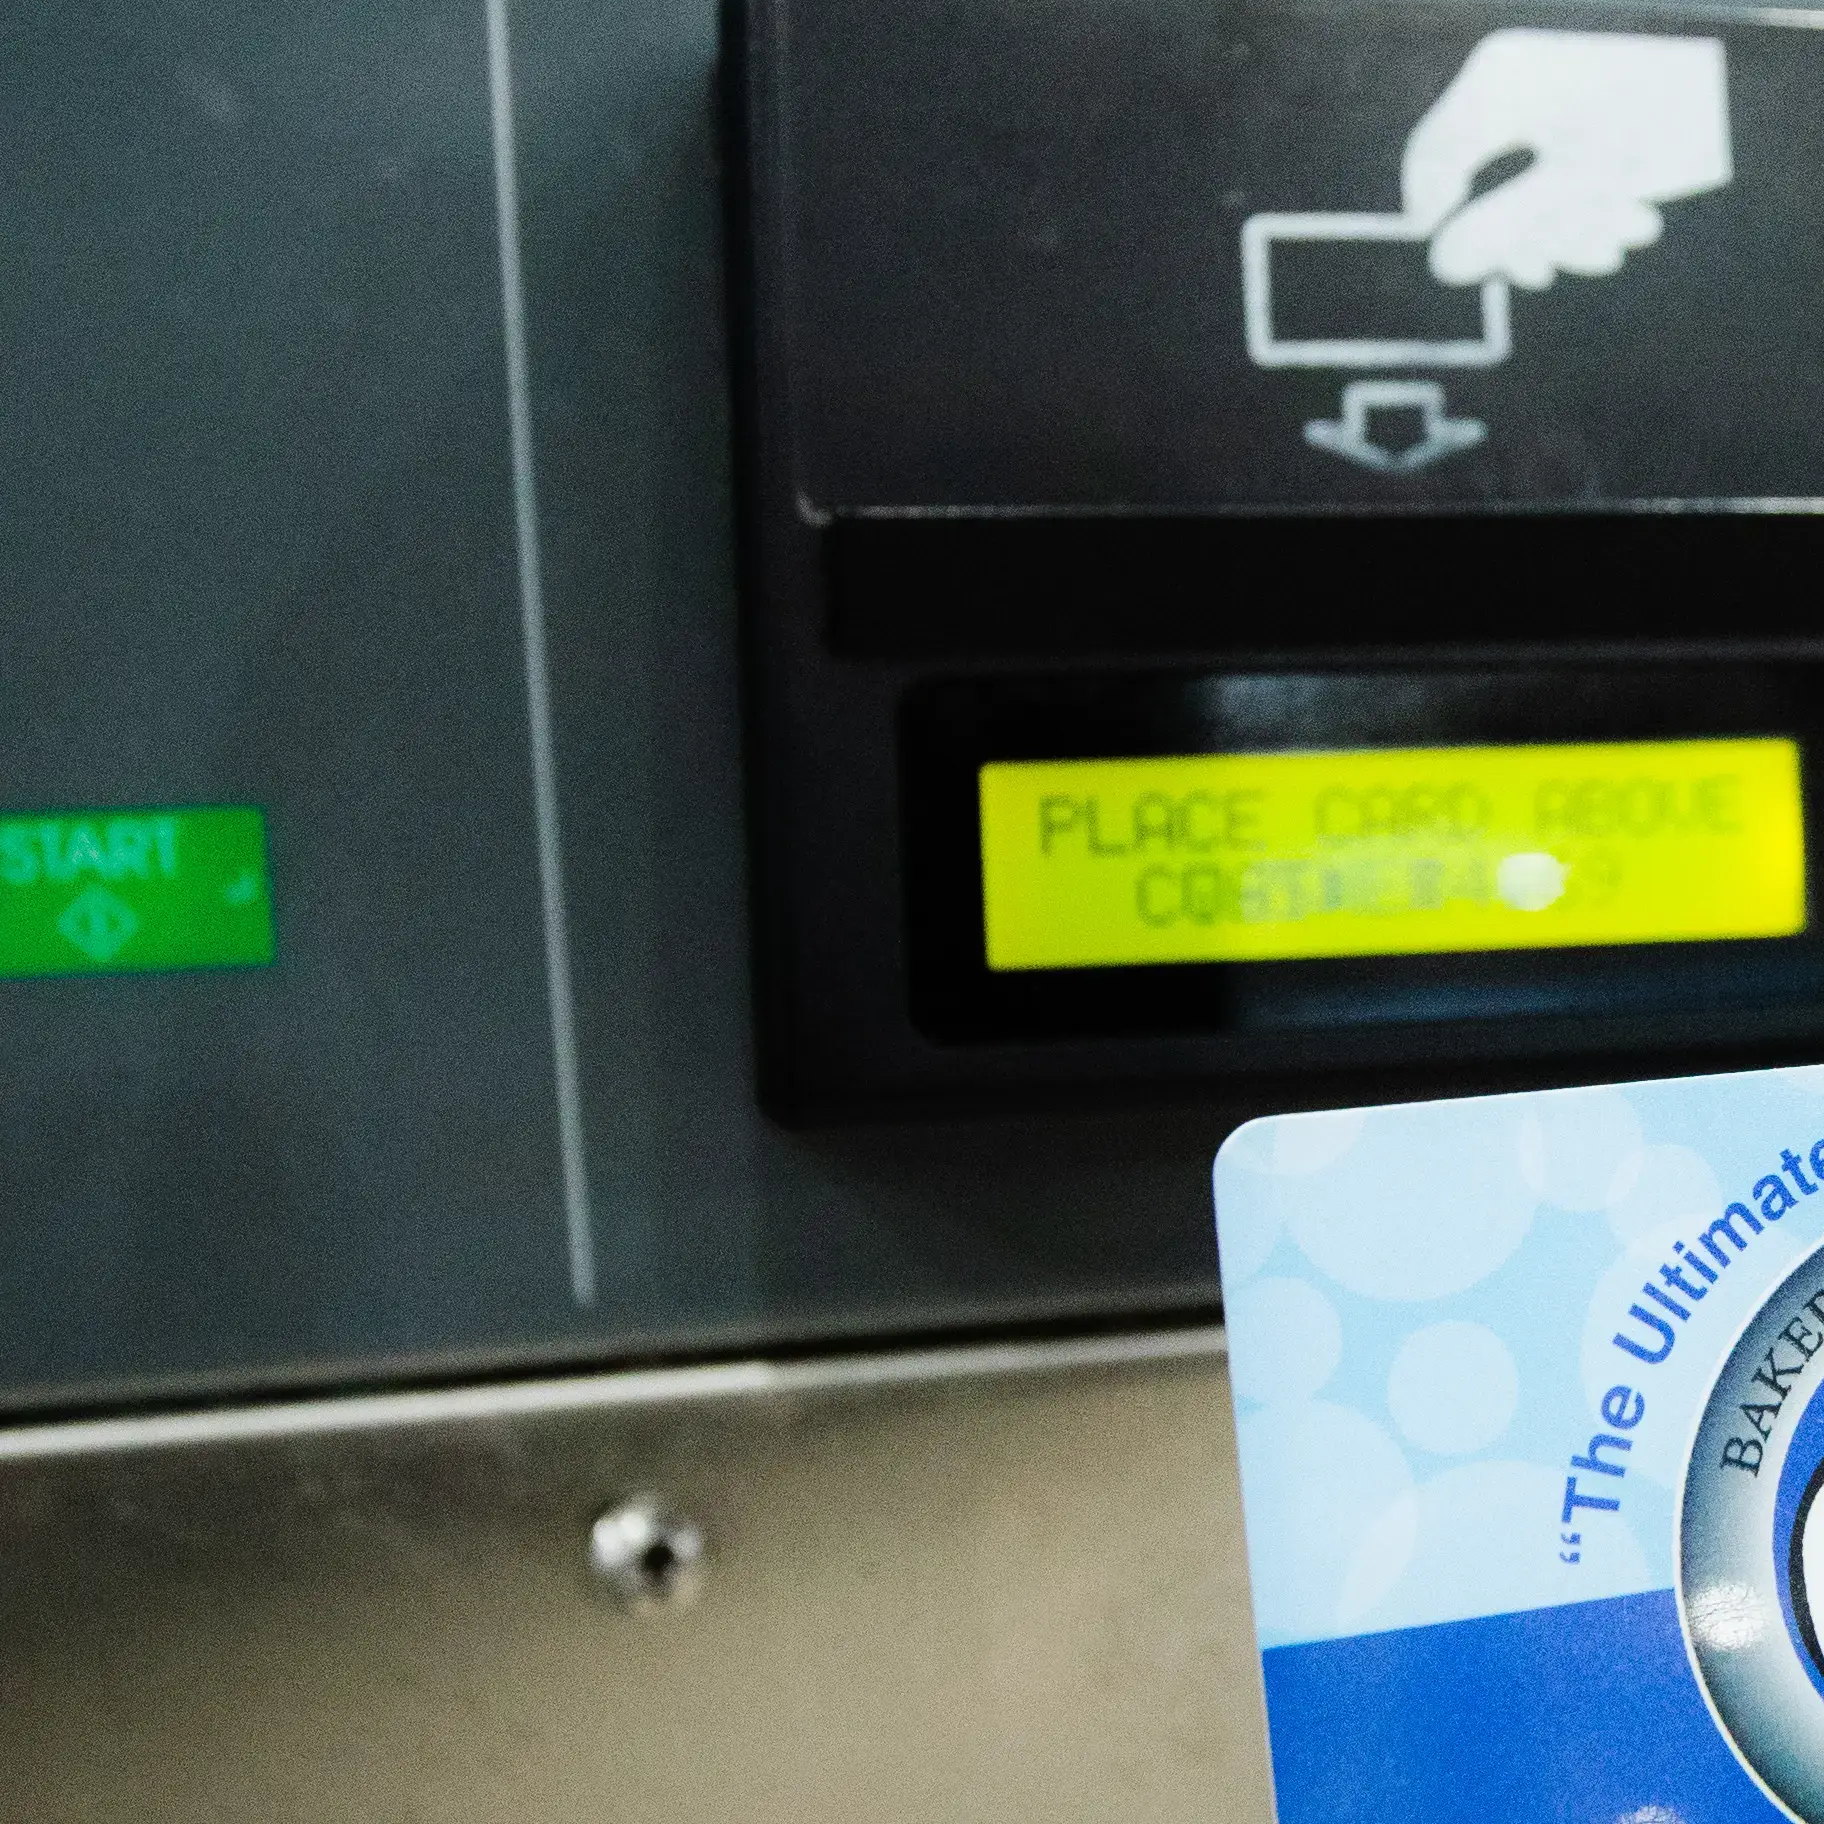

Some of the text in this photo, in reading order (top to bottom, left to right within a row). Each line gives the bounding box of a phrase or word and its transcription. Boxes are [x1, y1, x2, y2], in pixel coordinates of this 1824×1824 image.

[0, 818, 176, 884] START
[1038, 774, 1744, 856] PLACE CARD ABOVE
